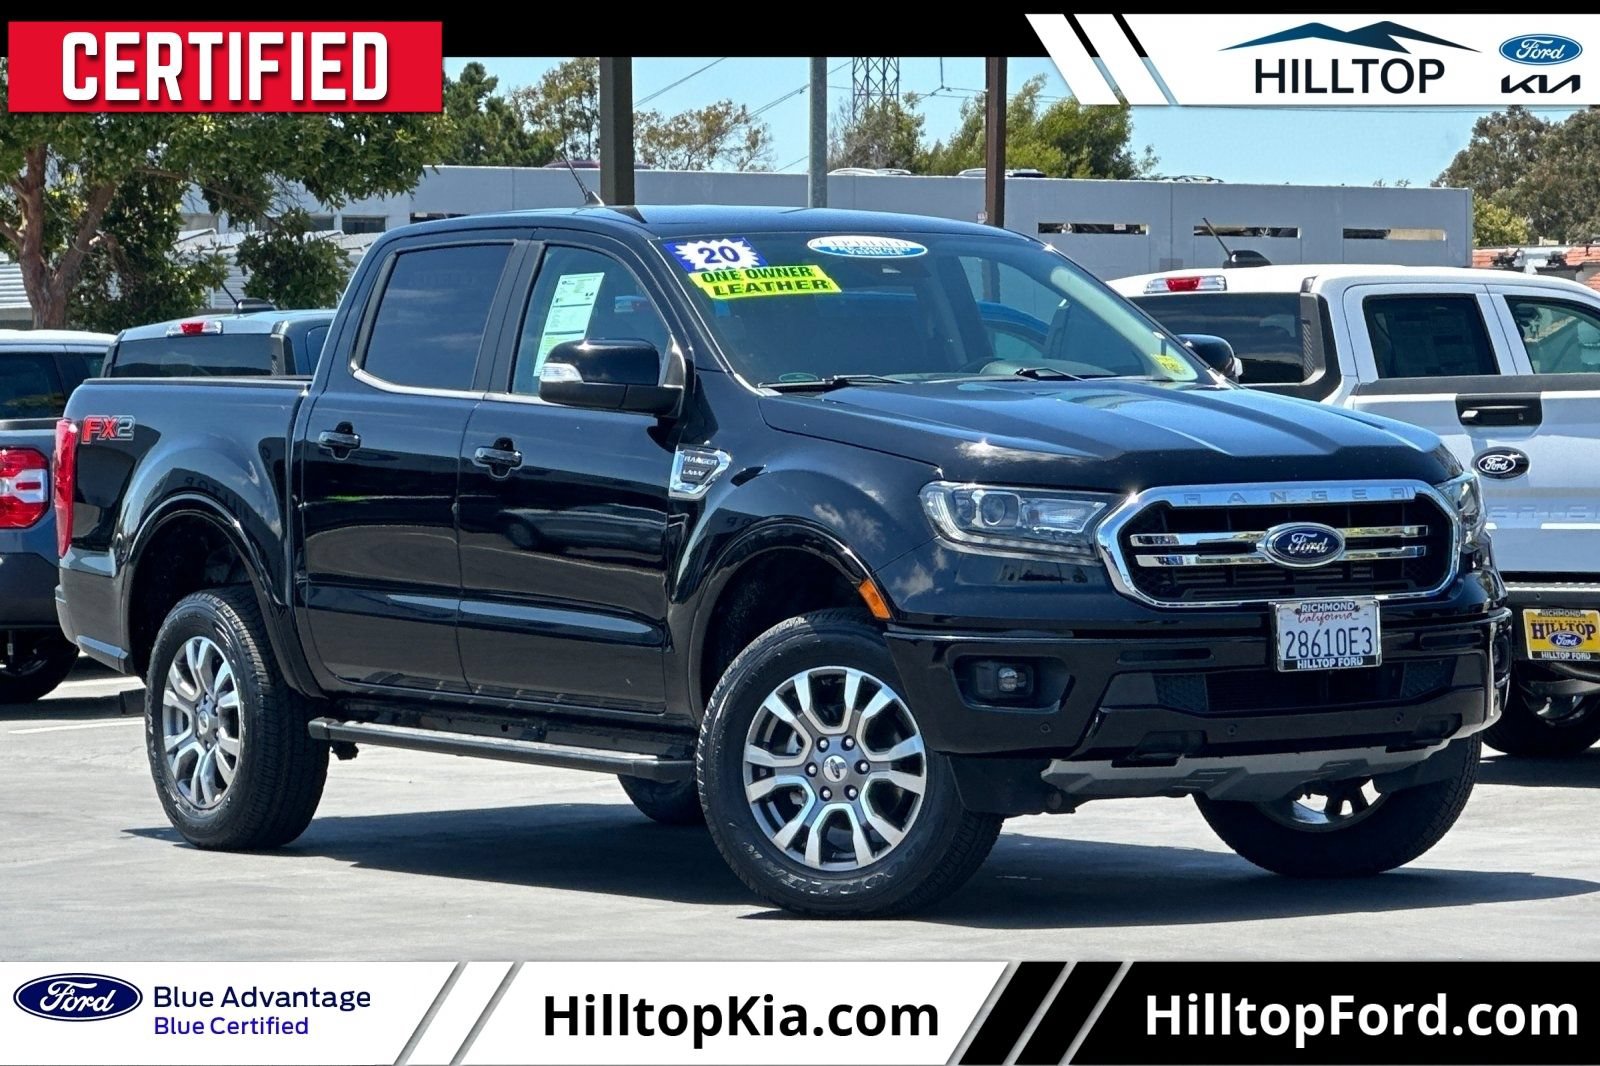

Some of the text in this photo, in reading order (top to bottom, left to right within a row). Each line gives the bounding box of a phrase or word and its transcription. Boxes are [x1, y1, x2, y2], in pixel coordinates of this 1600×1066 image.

[697, 245, 740, 264] 20
[701, 267, 812, 283] ONE OWNER
[713, 279, 829, 296] LEATHER
[81, 415, 136, 444] FX2
[1485, 458, 1508, 470] Ford
[1183, 488, 1405, 505] RANGER
[1288, 532, 1329, 554] Ford
[1301, 602, 1355, 613] RICHMOND
[1298, 611, 1357, 626] California
[1530, 622, 1597, 640] HILLTOP
[1285, 627, 1373, 659] 28610E3
[1556, 633, 1578, 646] Ford
[1297, 657, 1363, 669] HILLTOP FORD
[1541, 651, 1591, 660] HILLTOP FORD
